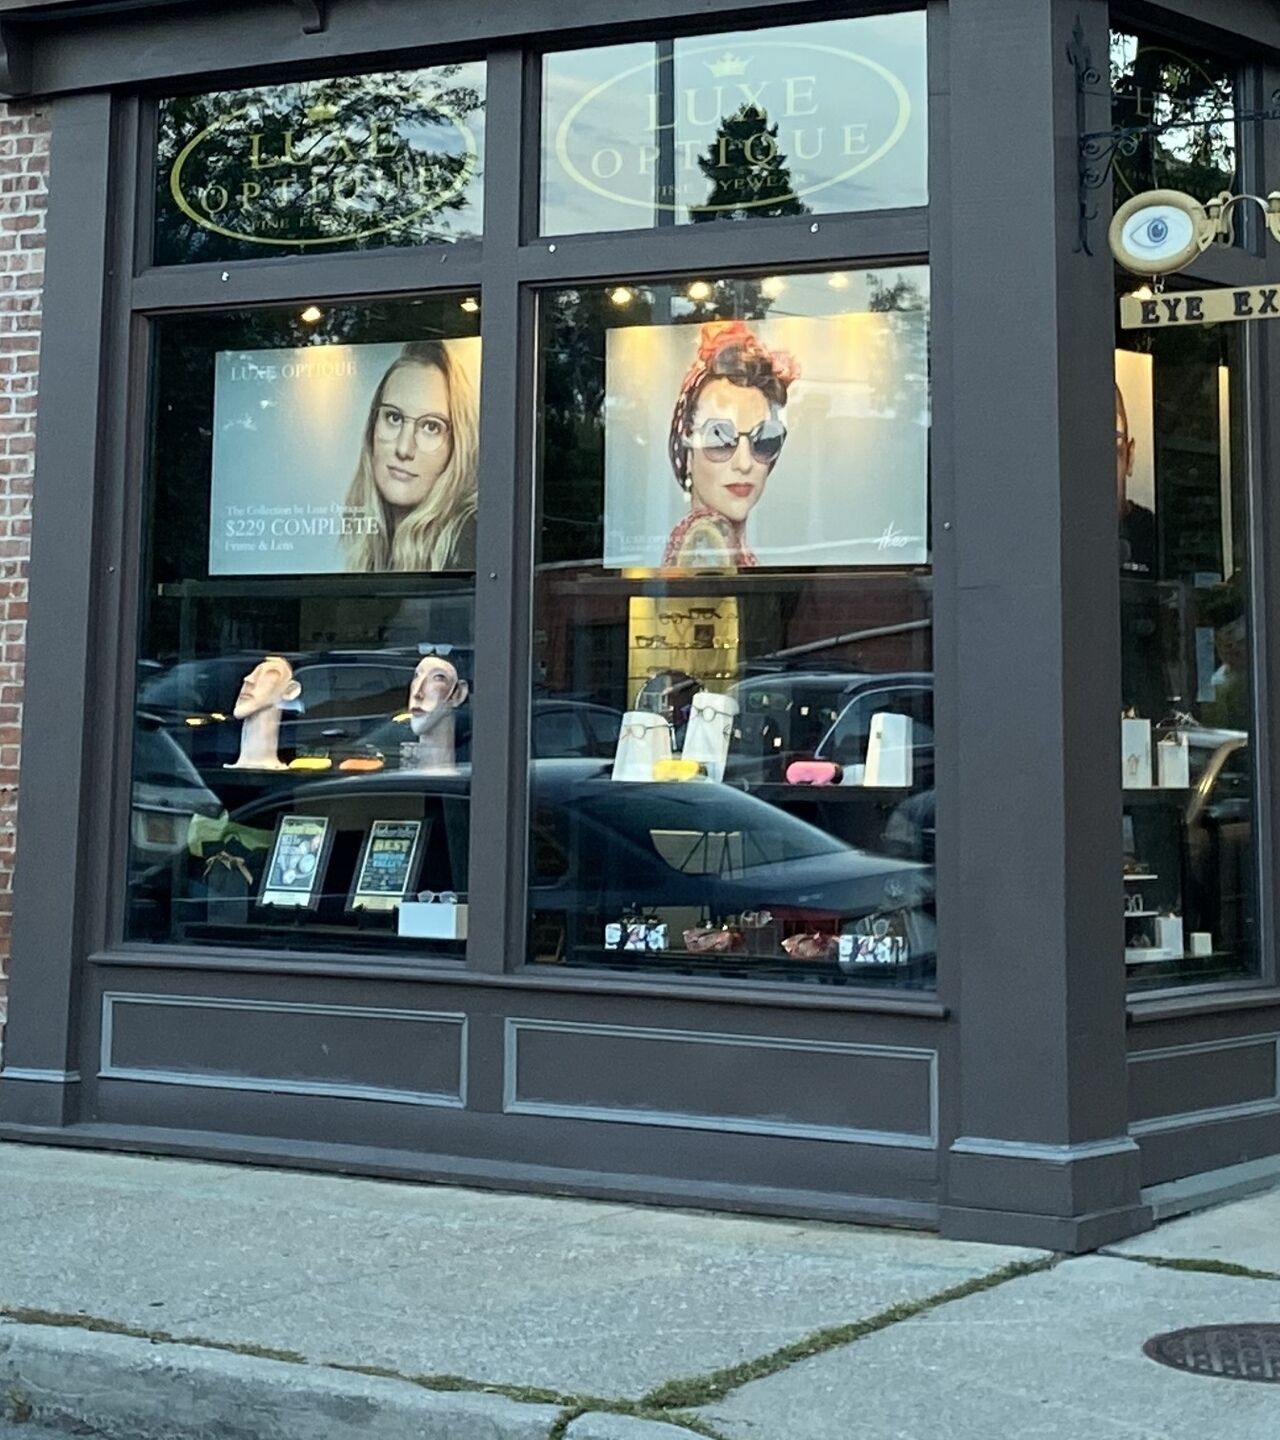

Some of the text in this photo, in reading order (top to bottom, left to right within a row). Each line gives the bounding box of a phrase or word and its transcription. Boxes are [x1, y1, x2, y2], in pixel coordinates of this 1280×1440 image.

[643, 76, 818, 131] LUXE
[249, 120, 400, 169] LUXE
[591, 123, 869, 179] OPTIQUE
[707, 173, 807, 193] YEWEAR
[1140, 296, 1204, 324] EYE
[231, 361, 358, 381] LUXE OPTIQUE
[225, 516, 380, 537] $229 COMPLETE
[258, 540, 268, 550] &
